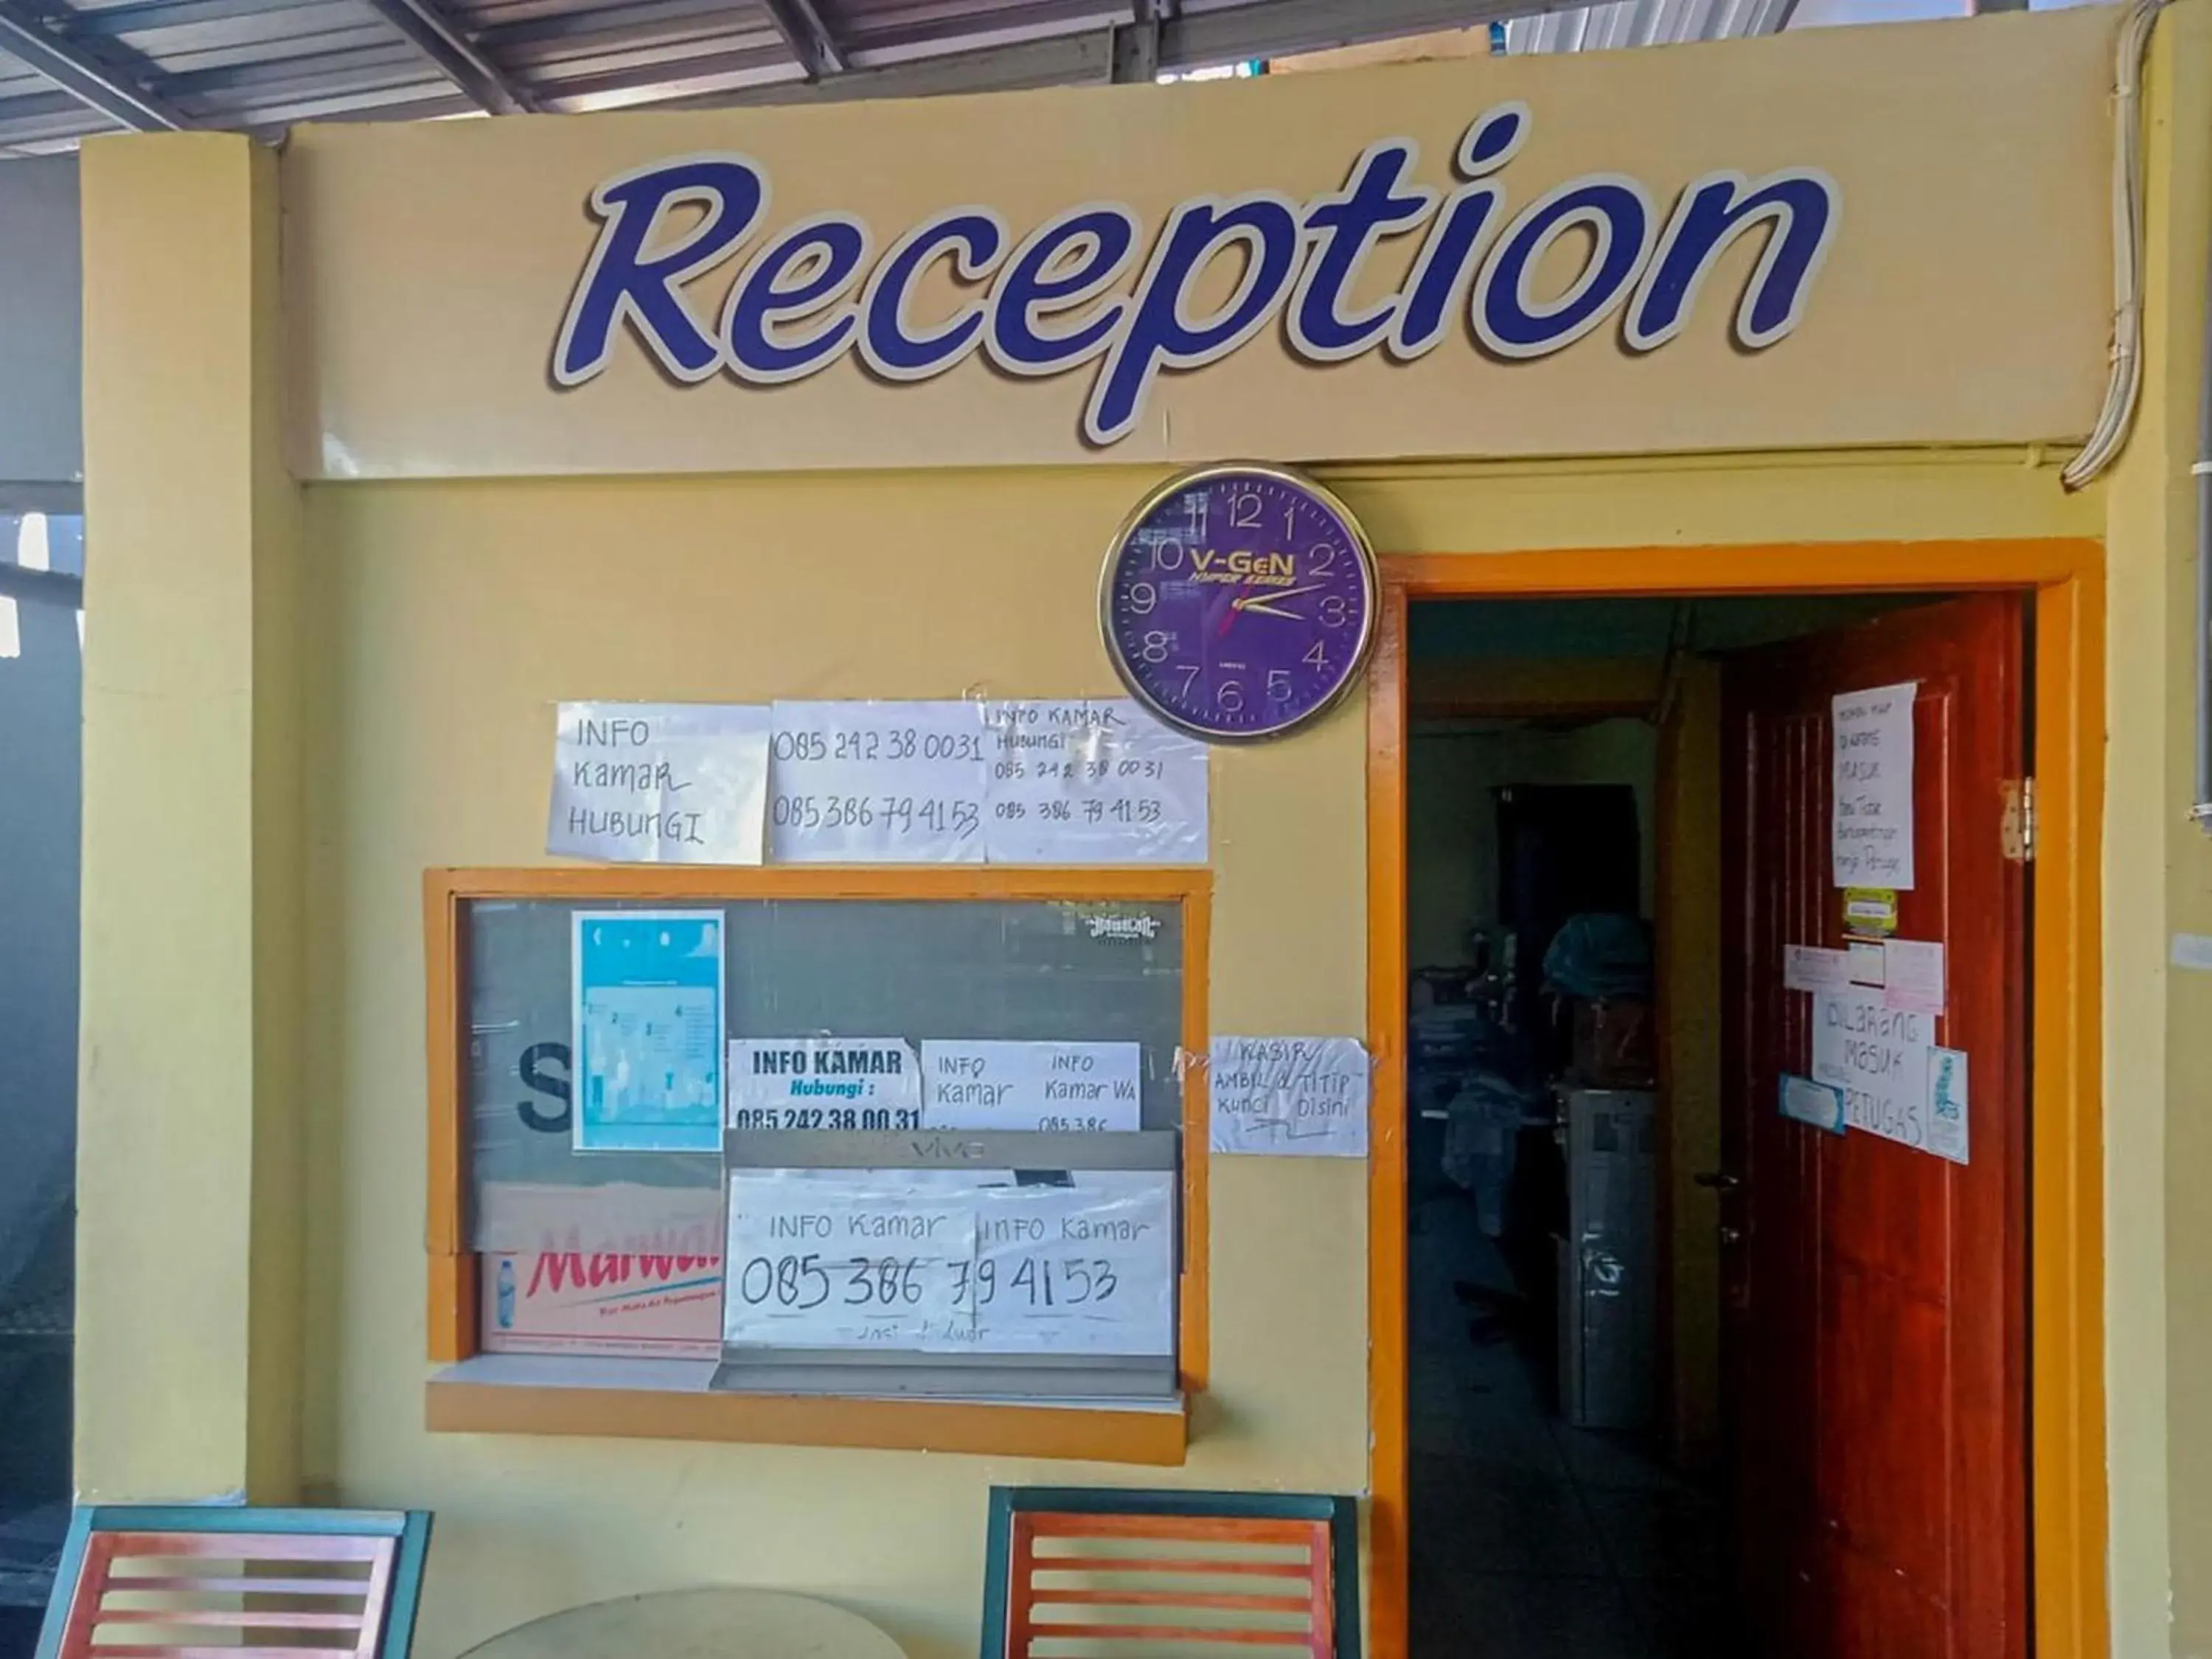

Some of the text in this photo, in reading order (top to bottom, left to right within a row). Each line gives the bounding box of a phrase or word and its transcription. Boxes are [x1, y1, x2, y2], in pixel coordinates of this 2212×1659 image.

[550, 101, 1841, 444] Reception
[1228, 493, 1262, 528] 12
[1284, 507, 1295, 540] 1
[1151, 538, 1183, 570] 10
[1309, 543, 1335, 576] 2
[1130, 583, 1156, 614] 9
[1318, 596, 1346, 627] 3
[1143, 631, 1167, 662] 8
[1302, 641, 1329, 672] 4
[1177, 665, 1200, 698] 7
[1217, 681, 1243, 713] 6
[1267, 669, 1292, 701] 5
[1048, 707, 1126, 726] KAMAR
[577, 719, 650, 746] INFO
[774, 731, 826, 760] 085
[886, 728, 917, 759] 38
[924, 734, 984, 762] 0031
[995, 762, 1024, 779] 085
[773, 795, 820, 827] 085
[826, 796, 872, 827] 386
[995, 802, 1026, 818] 085
[753, 1050, 902, 1074] INFO KAMAR
[939, 1057, 985, 1078] INFO
[1051, 1055, 1093, 1072] INFO
[790, 1079, 865, 1099] Hubungi
[738, 1109, 777, 1130] 085
[784, 1109, 823, 1130] 242
[828, 1109, 855, 1130] 38
[770, 1215, 832, 1239] INFO
[742, 1253, 830, 1310] 085
[843, 1256, 922, 1305] 386
